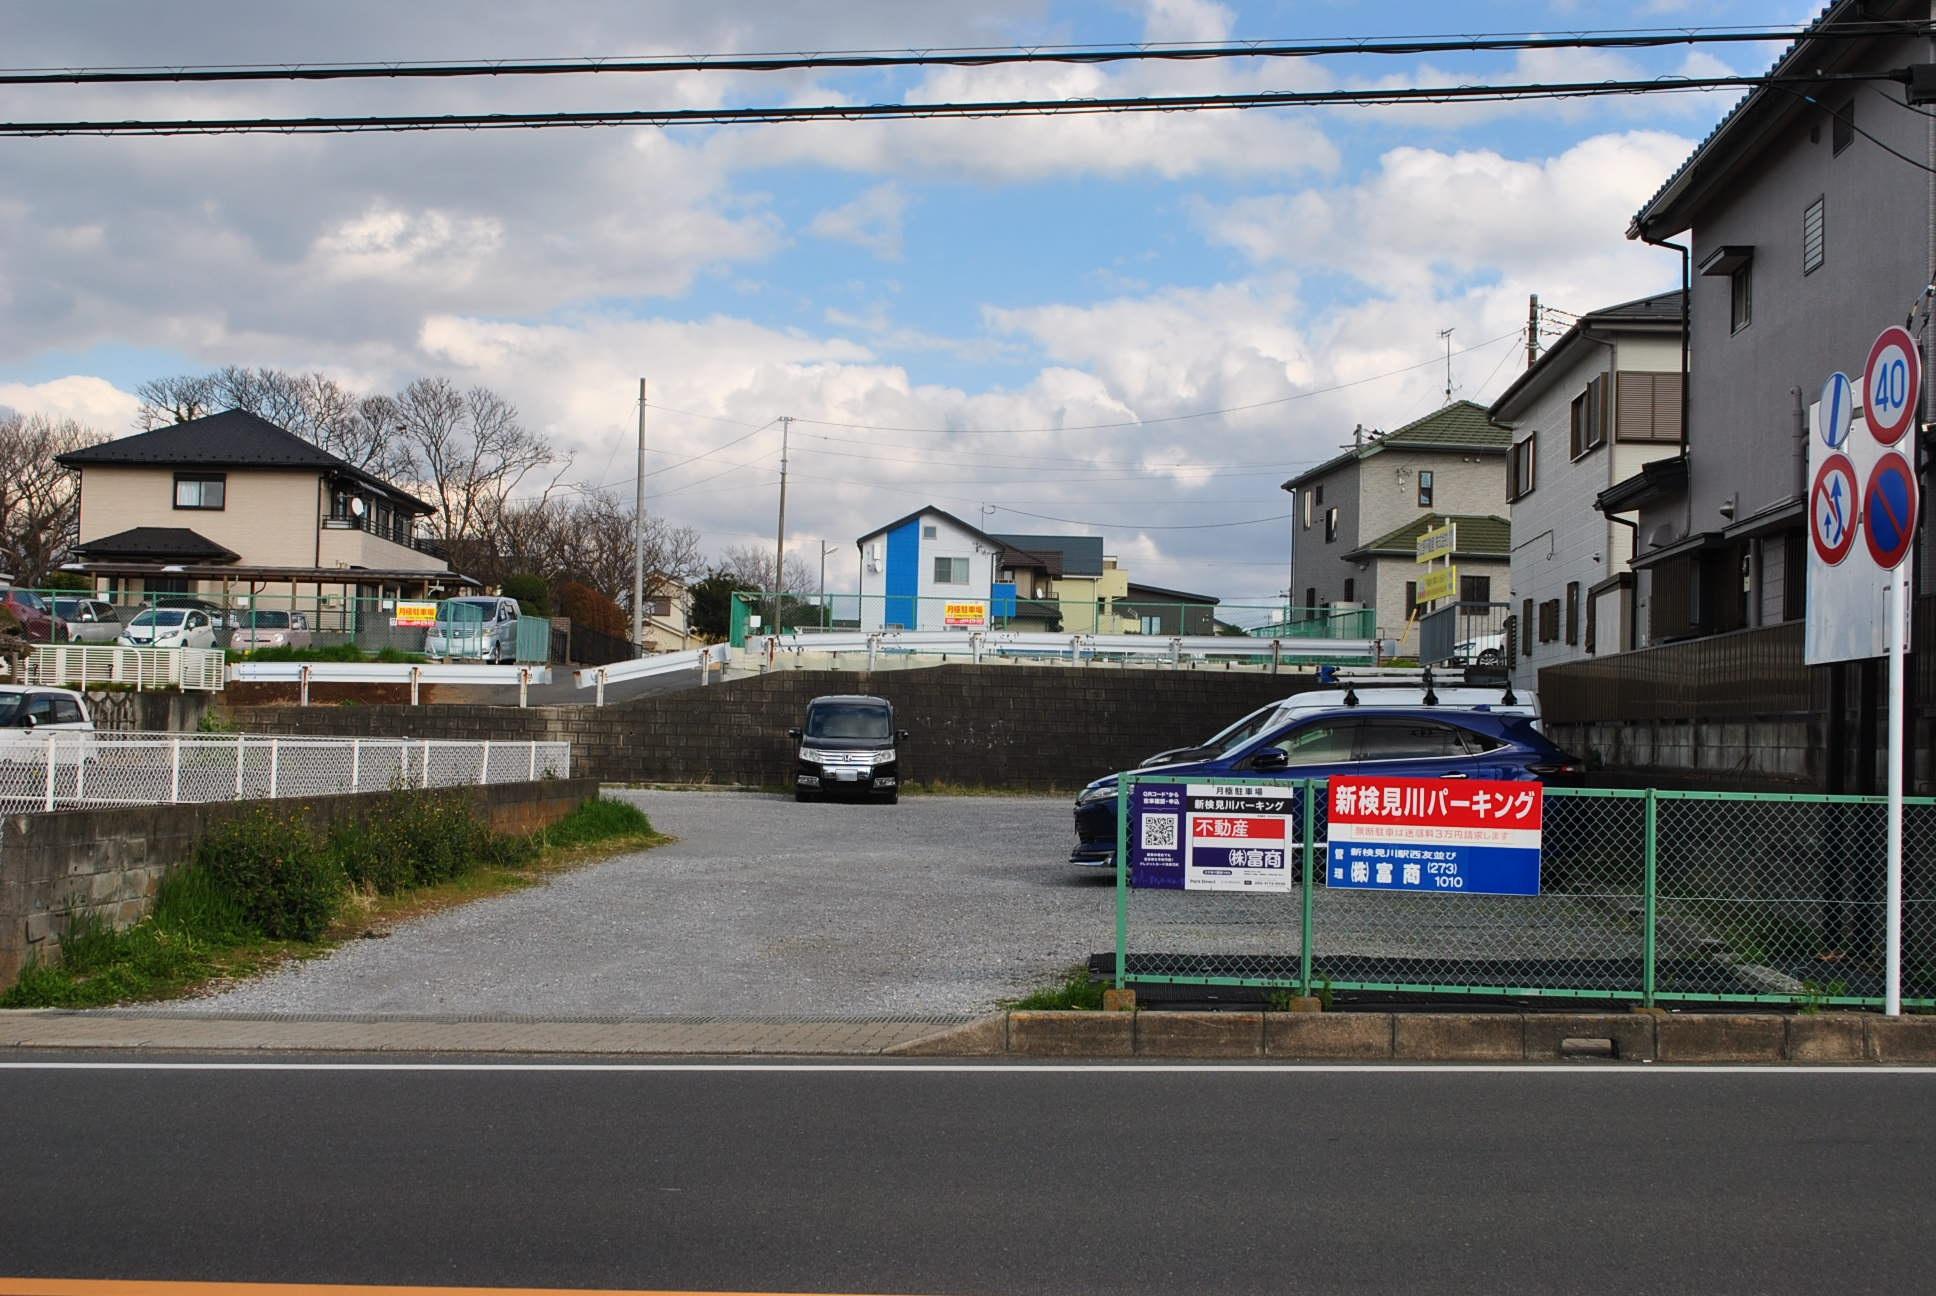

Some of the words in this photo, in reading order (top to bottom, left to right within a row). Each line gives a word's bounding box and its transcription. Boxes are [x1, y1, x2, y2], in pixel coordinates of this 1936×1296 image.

[1874, 358, 1906, 413] 40
[1215, 786, 1264, 797] 月極駐車場
[1194, 799, 1285, 811] 新検見川パーキング
[1335, 785, 1535, 820] 新検見川パーキング
[1195, 819, 1249, 837] 不動産
[1350, 848, 1457, 861] 新検見川駅西友並び
[1427, 861, 1458, 875] (273)
[1434, 876, 1463, 888] 1010
